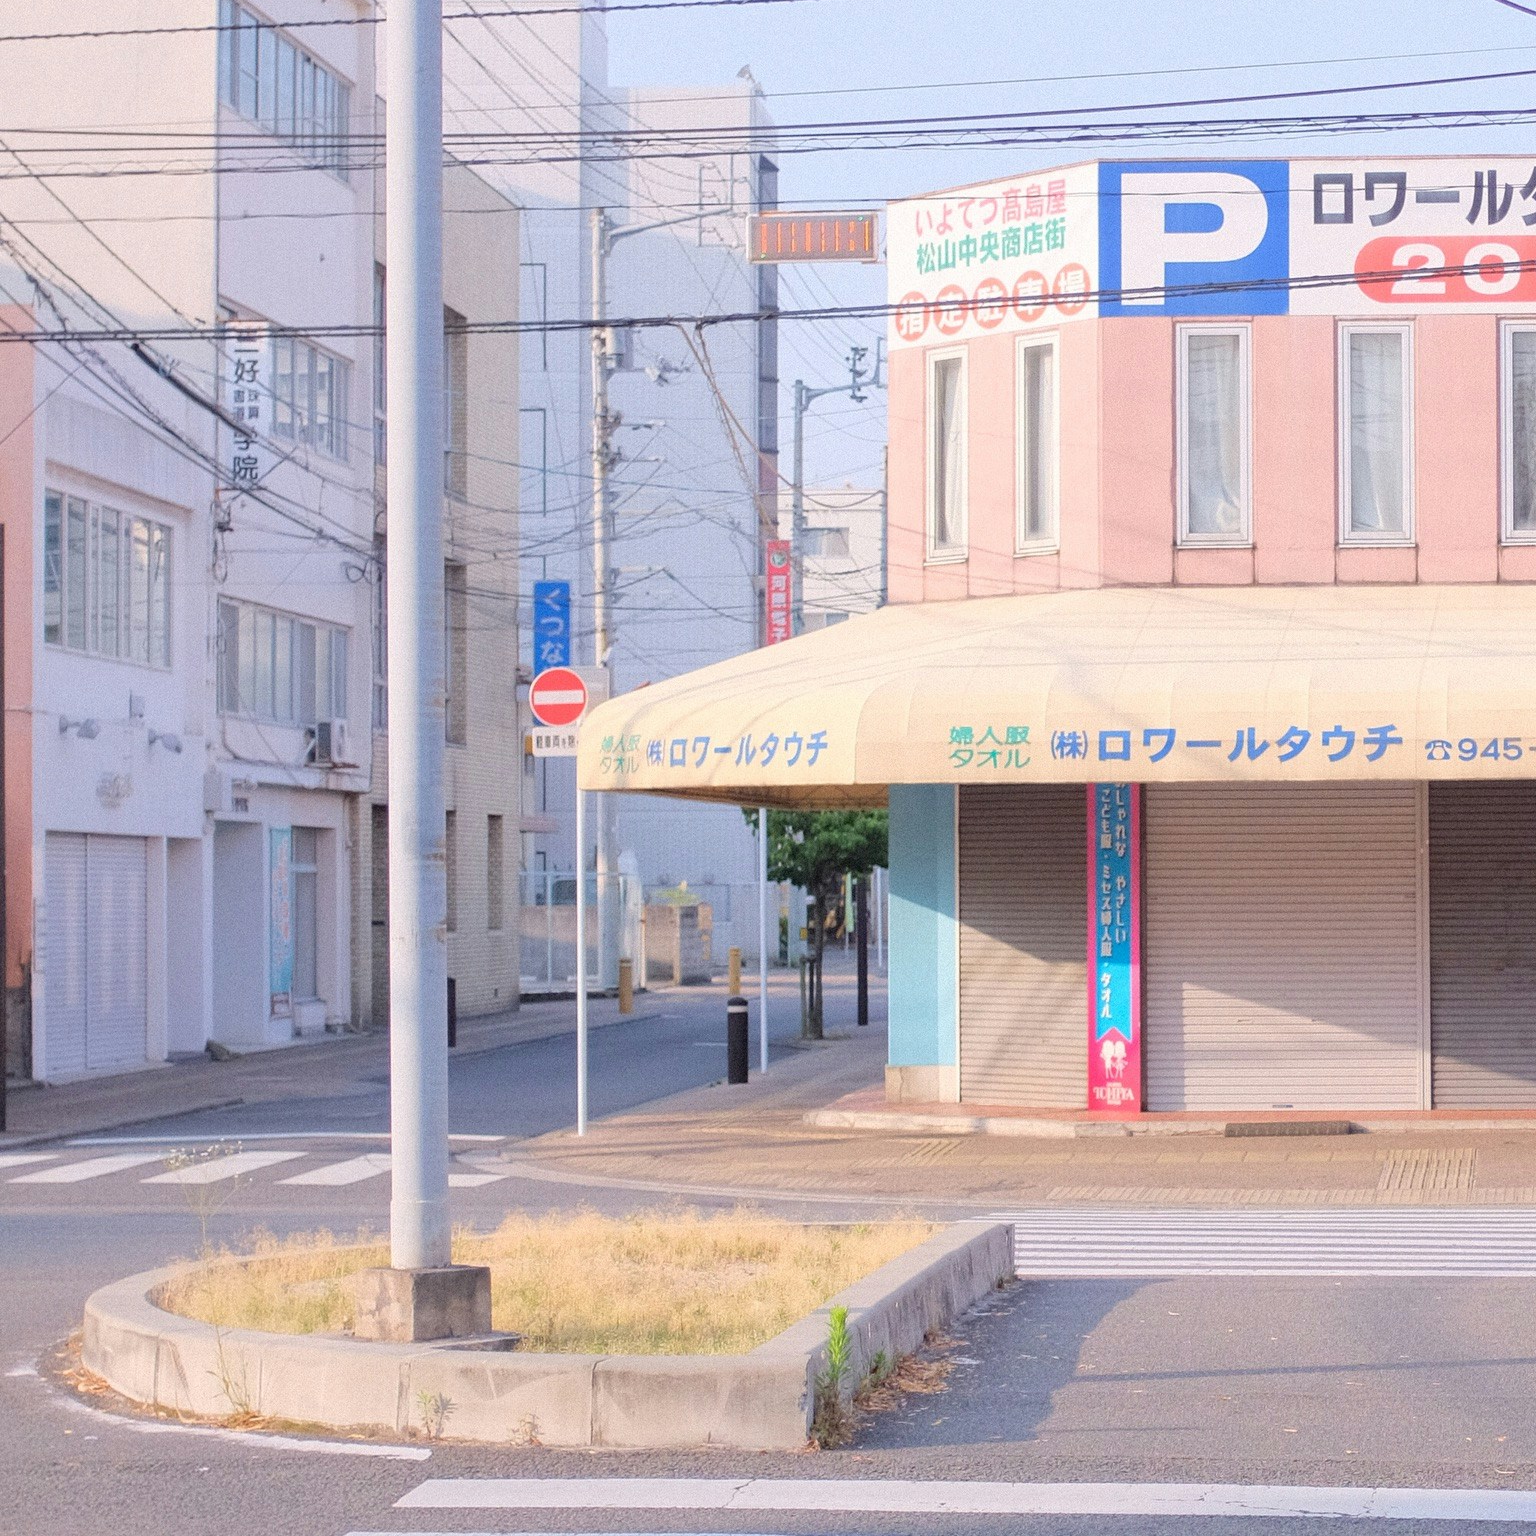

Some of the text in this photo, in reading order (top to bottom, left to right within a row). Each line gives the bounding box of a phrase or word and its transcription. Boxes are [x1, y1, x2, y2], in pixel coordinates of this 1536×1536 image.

[916, 217, 1066, 275] 松山中央商店街
[1121, 173, 1268, 305] P
[536, 735, 580, 749] 軽車両を除
[948, 726, 1030, 745] 婦人服
[948, 749, 1030, 769] タオル
[1115, 784, 1127, 857] しゃれな
